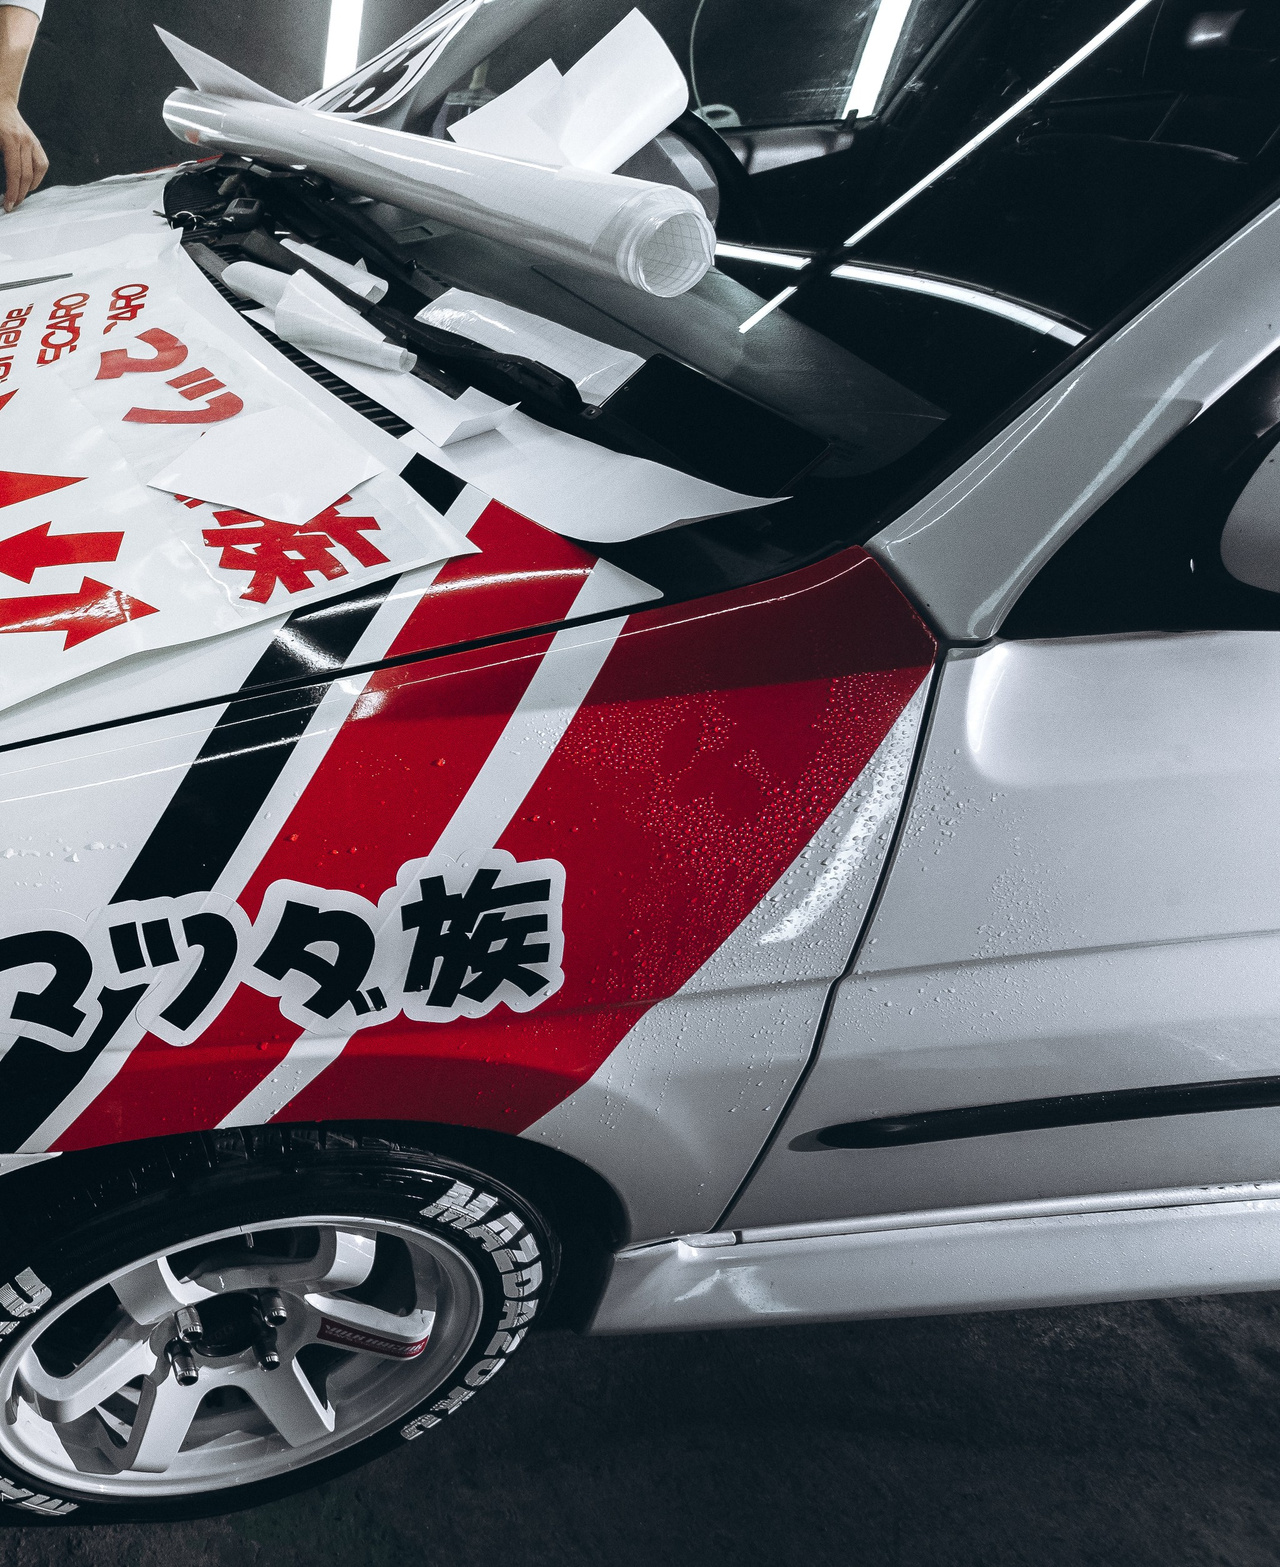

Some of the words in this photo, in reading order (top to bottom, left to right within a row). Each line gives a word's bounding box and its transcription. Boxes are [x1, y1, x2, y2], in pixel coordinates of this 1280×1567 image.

[37, 292, 90, 367] ECARO
[94, 327, 391, 605] マツ族
